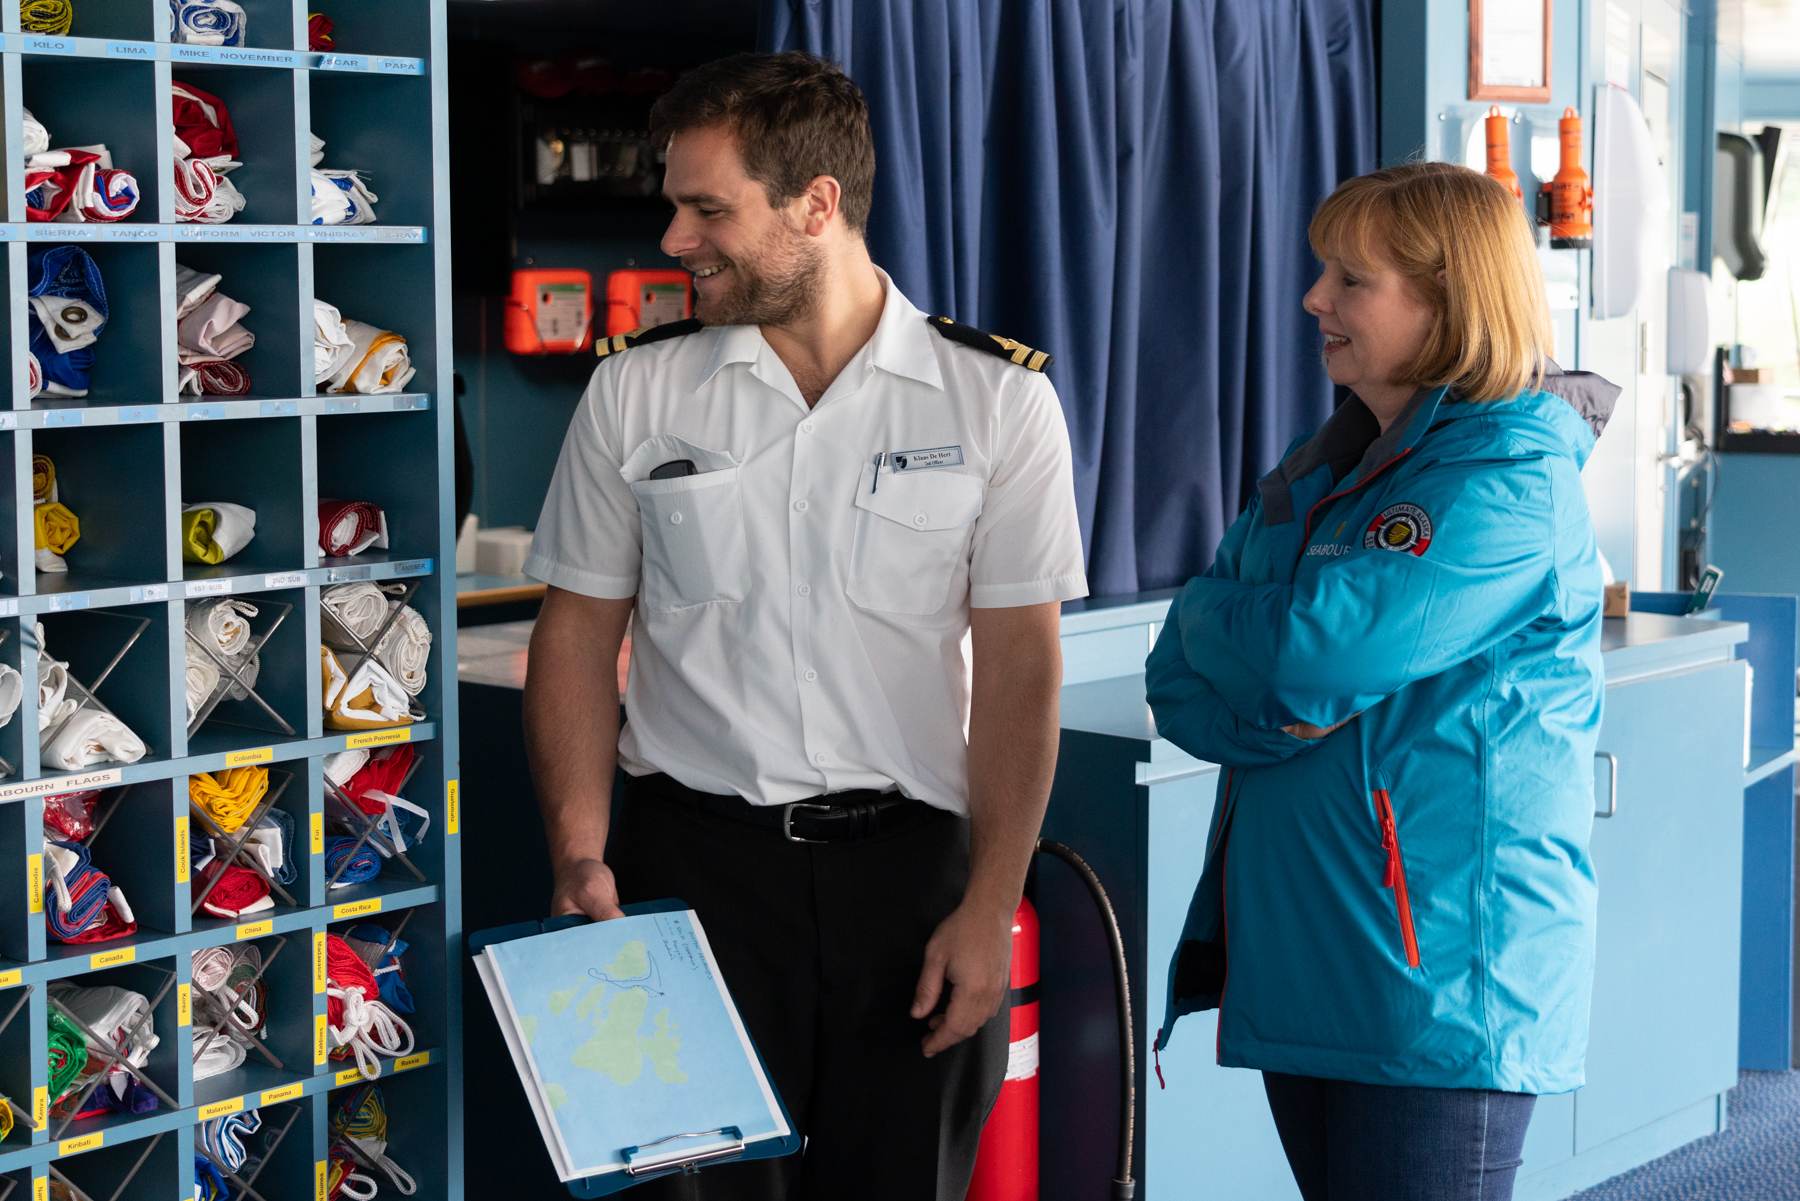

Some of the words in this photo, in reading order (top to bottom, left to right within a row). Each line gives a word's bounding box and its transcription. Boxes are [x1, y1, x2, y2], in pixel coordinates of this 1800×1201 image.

[33, 41, 65, 49] KILO
[116, 46, 147, 55] LIMA
[179, 49, 210, 58] MIKE
[220, 52, 293, 63] NOVEMBER
[385, 62, 416, 70] PAPA
[35, 229, 86, 237] SIERRA
[181, 230, 240, 238] UNIFORM
[249, 230, 296, 238] VICTOR
[1382, 505, 1417, 518] ULTIMATE
[1415, 511, 1430, 538] ALASKA
[287, 575, 301, 583] SUB
[353, 735, 373, 745] French
[374, 732, 401, 743] Polynesia
[233, 753, 262, 763] Colombia
[66, 774, 110, 787] FLAGS
[341, 905, 358, 914] Costa
[358, 903, 372, 912] Rica
[244, 926, 262, 935] China
[99, 953, 124, 964] Canada
[400, 1057, 420, 1067] Russia
[268, 1090, 292, 1101] Panama
[206, 1104, 233, 1115] Malaysia
[67, 1138, 92, 1150] Kiribati
